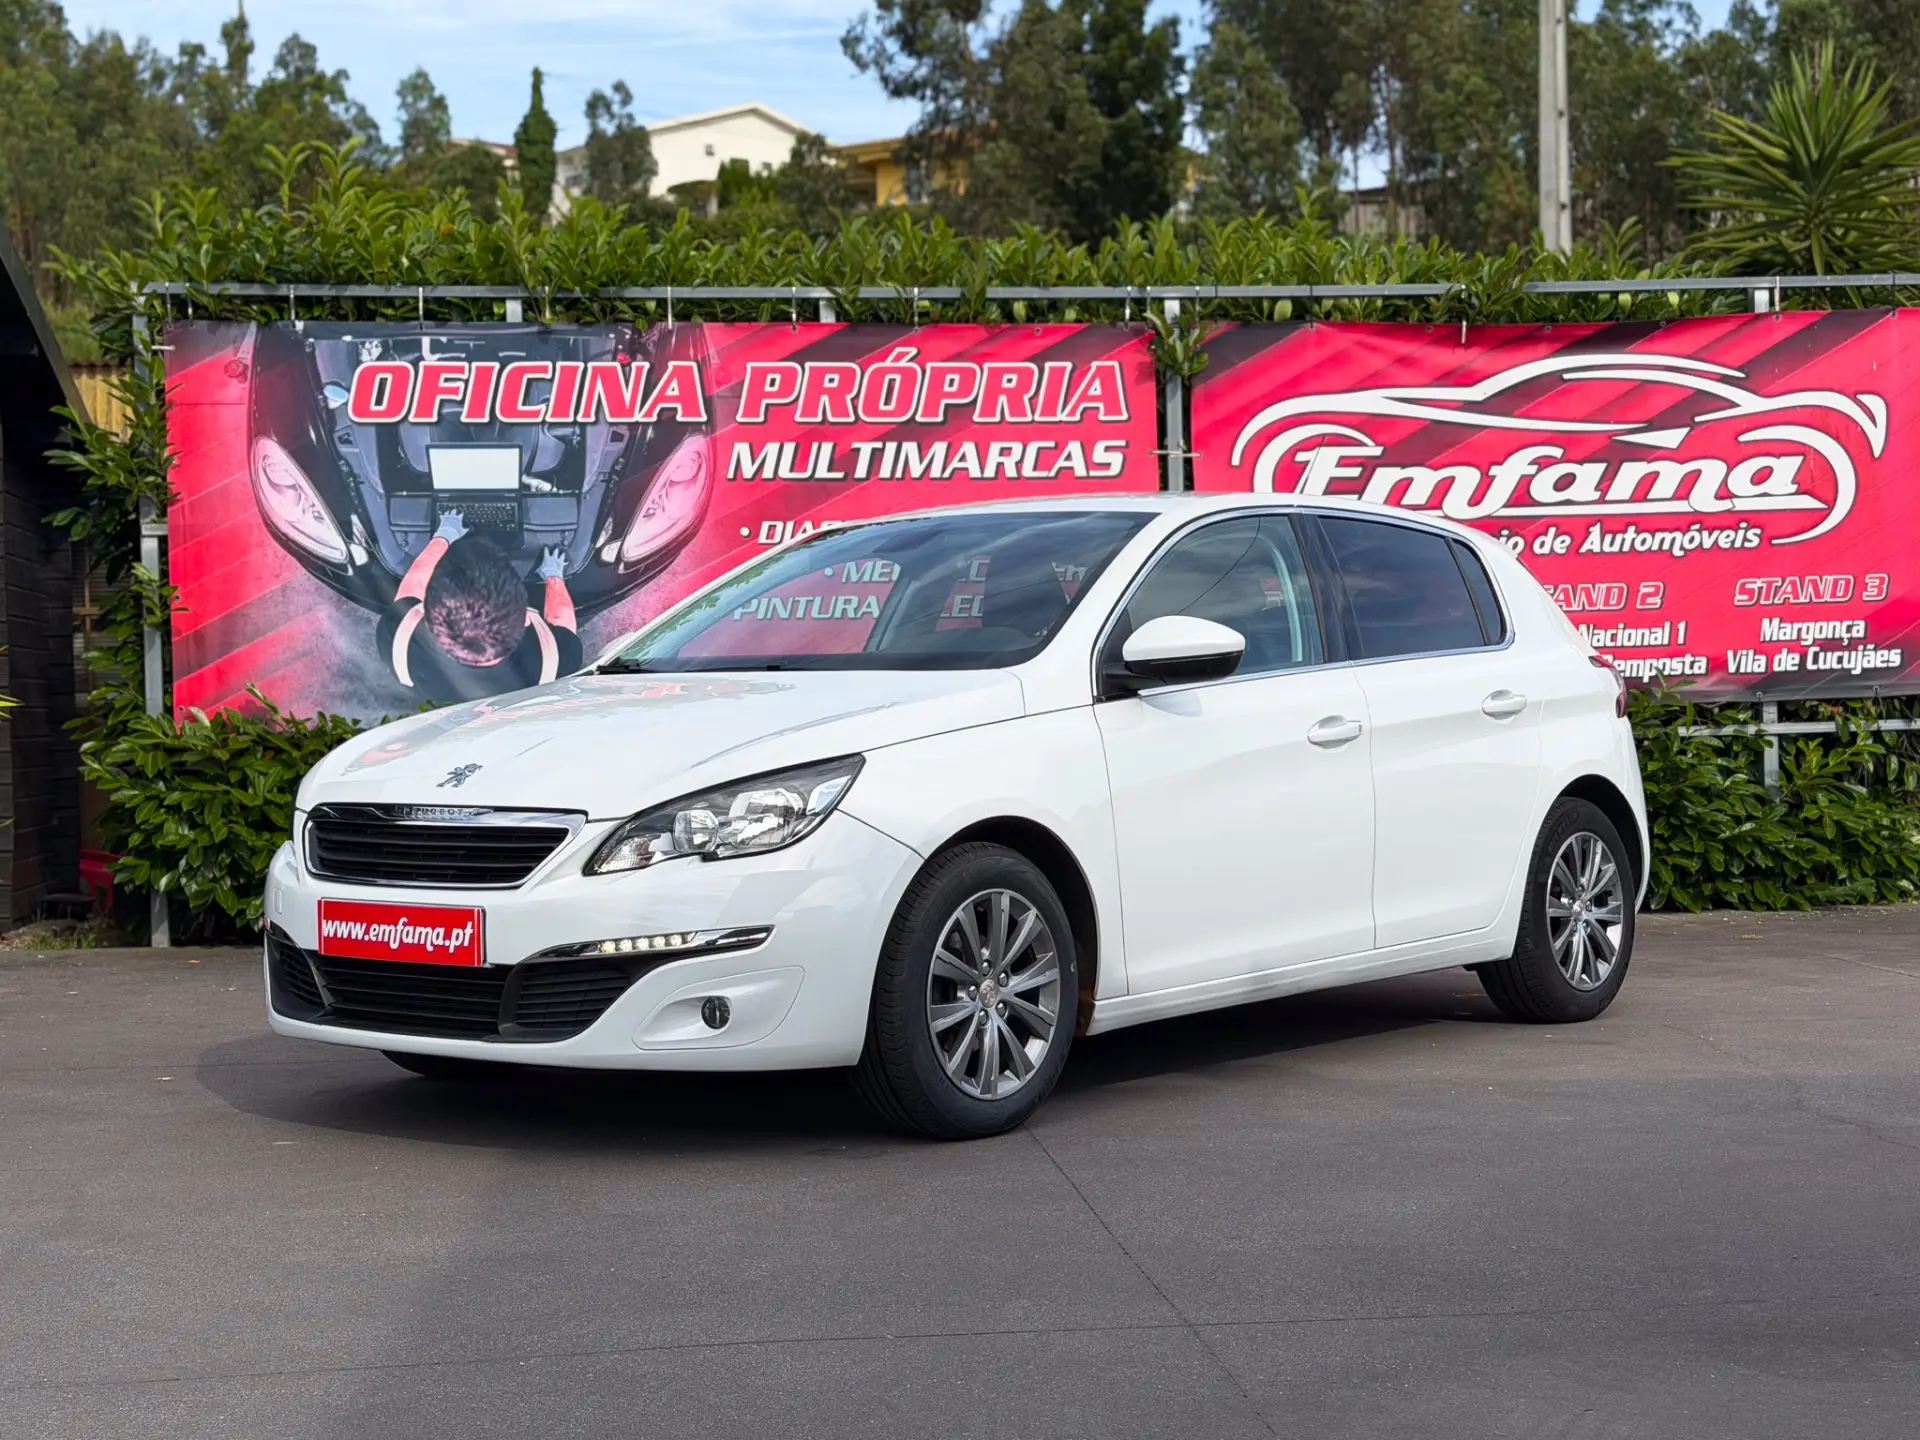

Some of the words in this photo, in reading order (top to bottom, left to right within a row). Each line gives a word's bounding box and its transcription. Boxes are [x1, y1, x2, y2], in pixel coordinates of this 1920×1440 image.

[347, 360, 708, 424] OFICINA
[735, 347, 1131, 424] PRÓPRIA
[725, 440, 1127, 481] MULTIMARCAS
[1293, 444, 1804, 520] Emfama
[1532, 526, 1572, 555] de
[1578, 521, 1762, 557] Automóveis
[1636, 581, 1664, 610] 2
[1734, 574, 1855, 607] STAND
[1862, 573, 1889, 602] 3
[1677, 620, 1687, 645] 1
[1760, 617, 1866, 647] Margonça
[1727, 648, 1767, 674] Vila
[1773, 647, 1801, 672] de
[1806, 643, 1902, 675] Cucujães
[322, 916, 474, 953] www.emfama.pt
